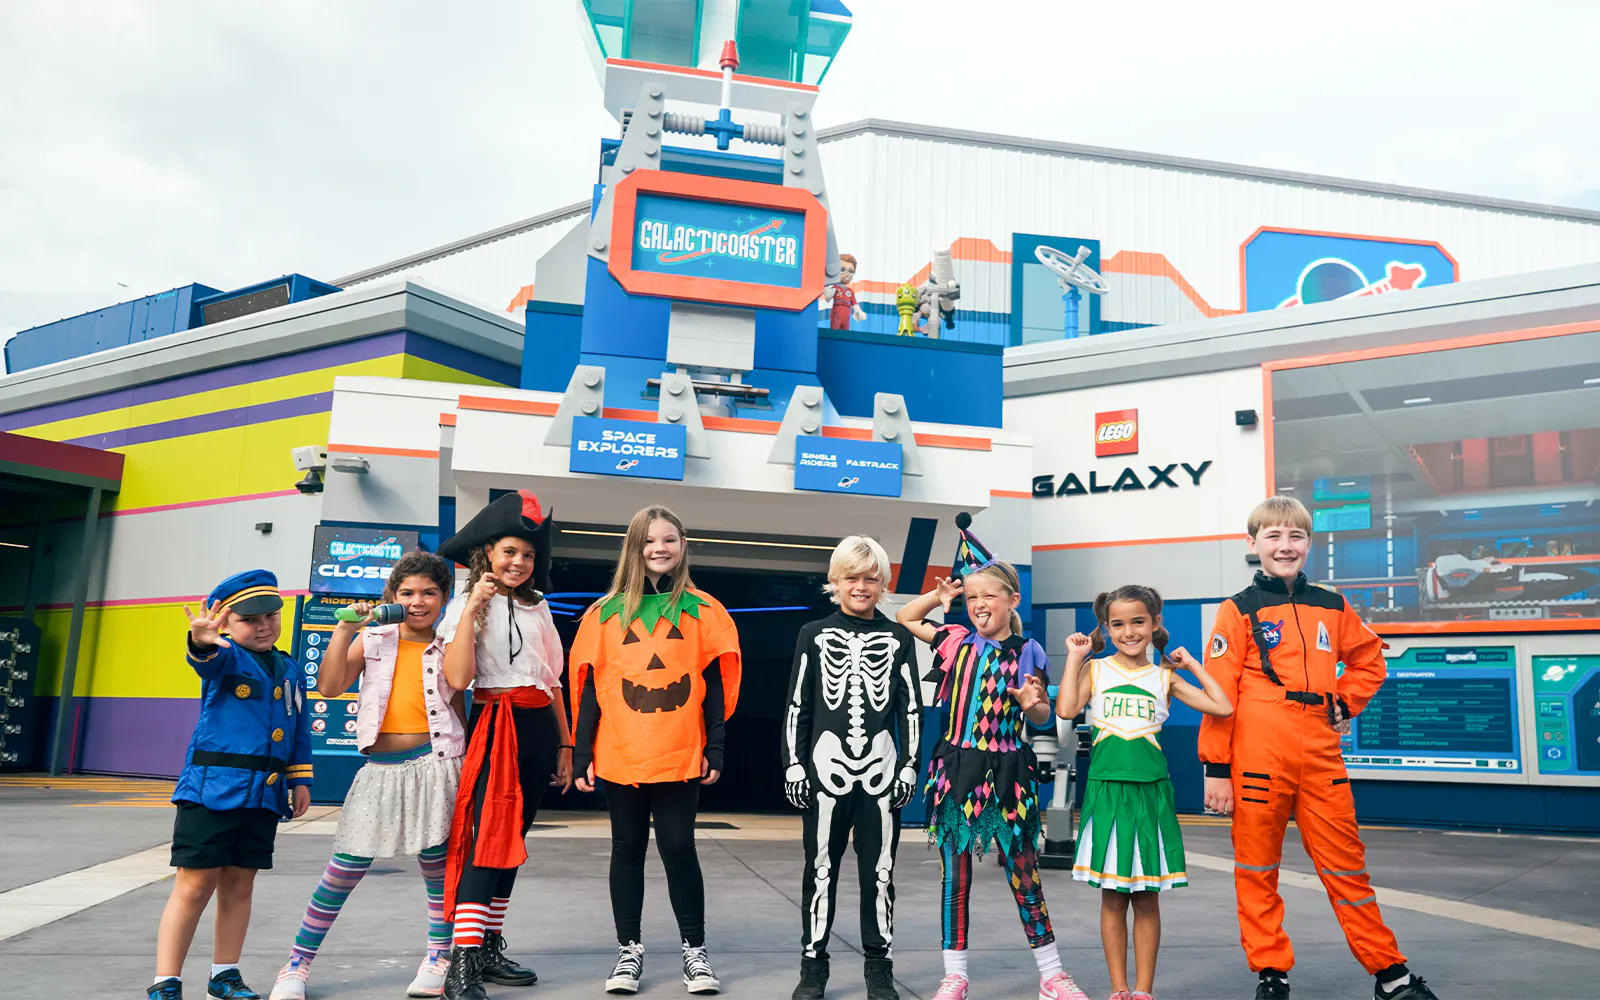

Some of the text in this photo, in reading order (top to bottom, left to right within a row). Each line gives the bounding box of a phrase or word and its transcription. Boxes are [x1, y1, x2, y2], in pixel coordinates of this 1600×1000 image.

[640, 220, 797, 266] GALACTICOASTER
[602, 430, 656, 445] SPACE
[1096, 421, 1135, 443] LEGO
[578, 440, 679, 459] EXPLORERS
[801, 453, 837, 461] SINGLE
[800, 459, 838, 468] RIDERS
[846, 459, 899, 470] FASTRACK
[1032, 460, 1213, 498] GALAXY
[318, 564, 395, 580] CLOSE
[321, 597, 356, 605] RIDER
[1104, 696, 1156, 722] CHEER
